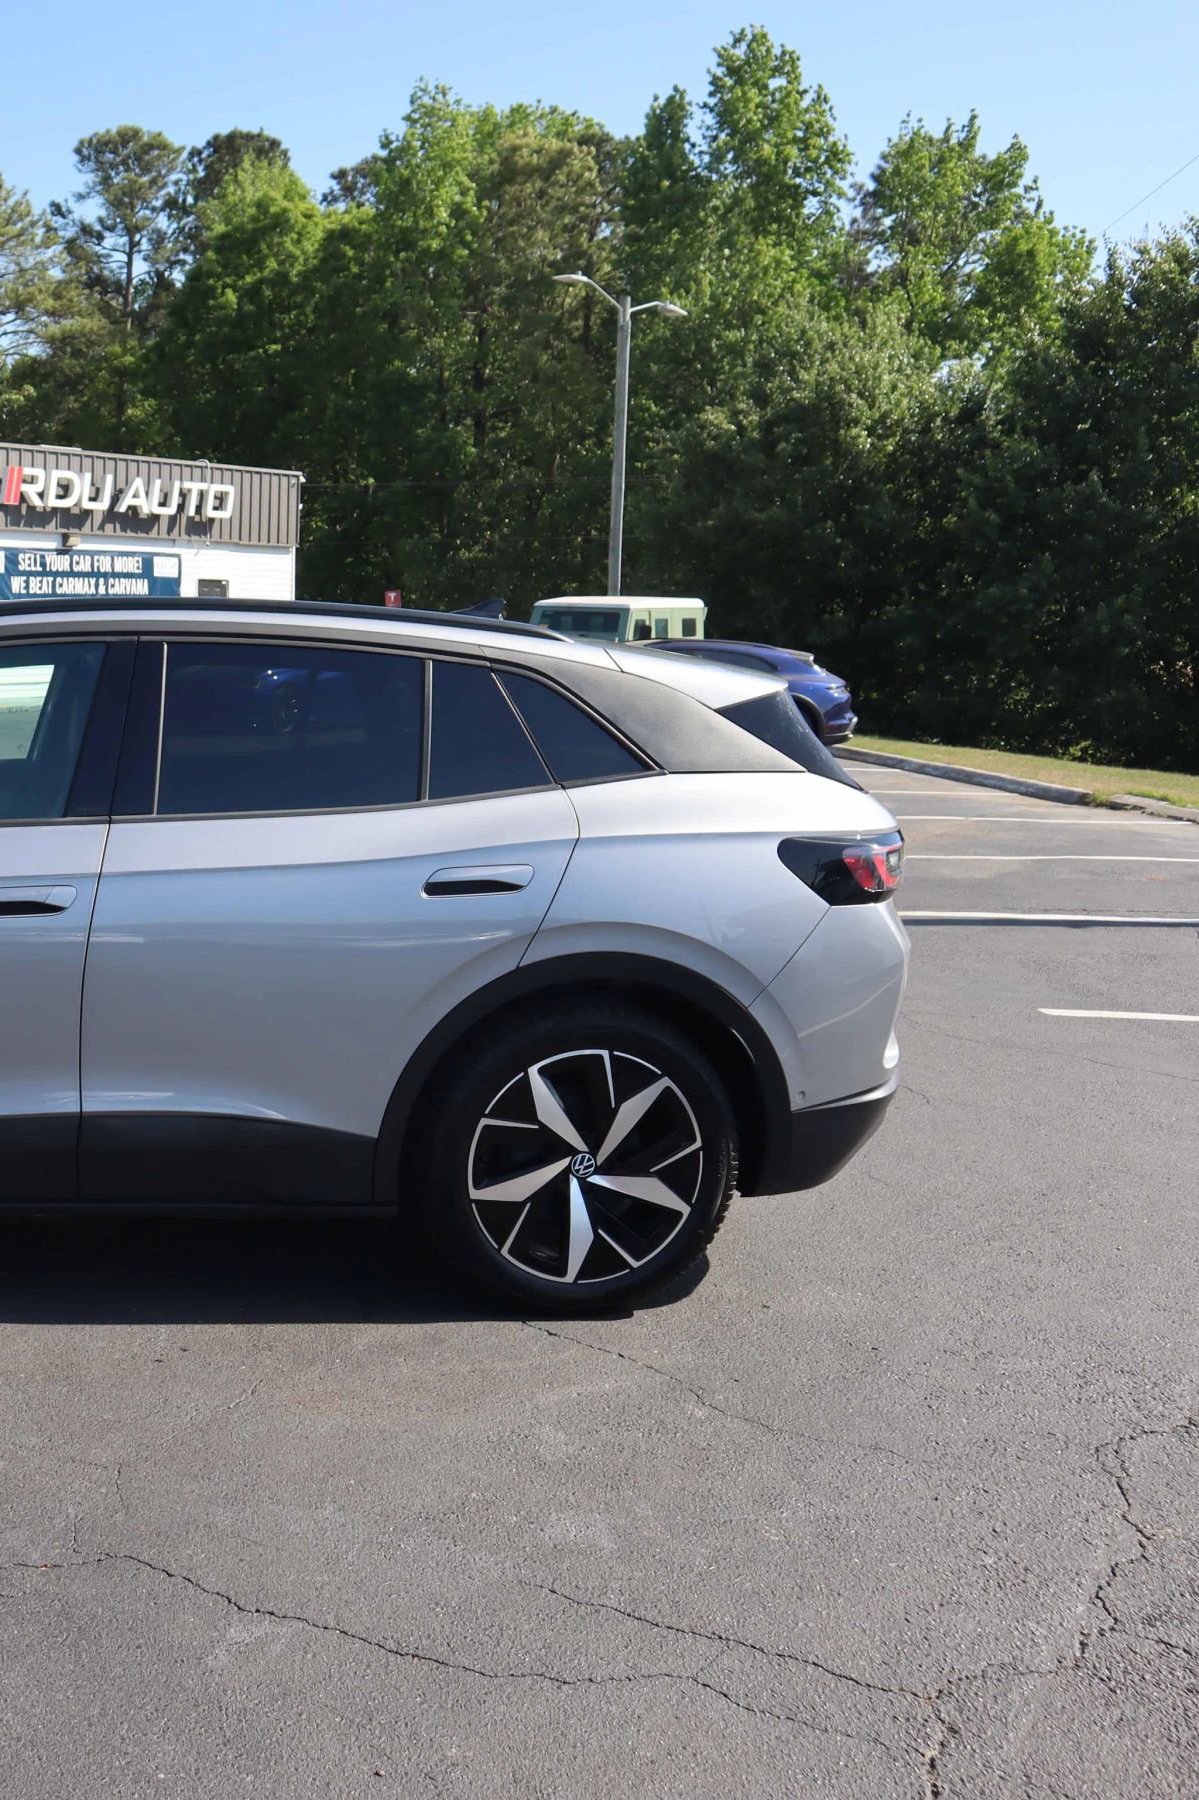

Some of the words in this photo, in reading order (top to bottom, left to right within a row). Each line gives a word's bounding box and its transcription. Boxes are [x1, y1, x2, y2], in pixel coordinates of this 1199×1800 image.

[2, 464, 113, 510] RDU
[114, 477, 235, 519] AUTO
[18, 553, 42, 571] SELL
[45, 554, 70, 572] YOUR
[73, 555, 92, 573] CAR
[94, 555, 112, 573] FOR
[114, 556, 142, 574] MORE!
[10, 576, 27, 594] WE
[29, 576, 53, 595] BEAT
[56, 577, 97, 595] CARMAX
[98, 577, 107, 595] &
[108, 578, 149, 596] CARVANA
